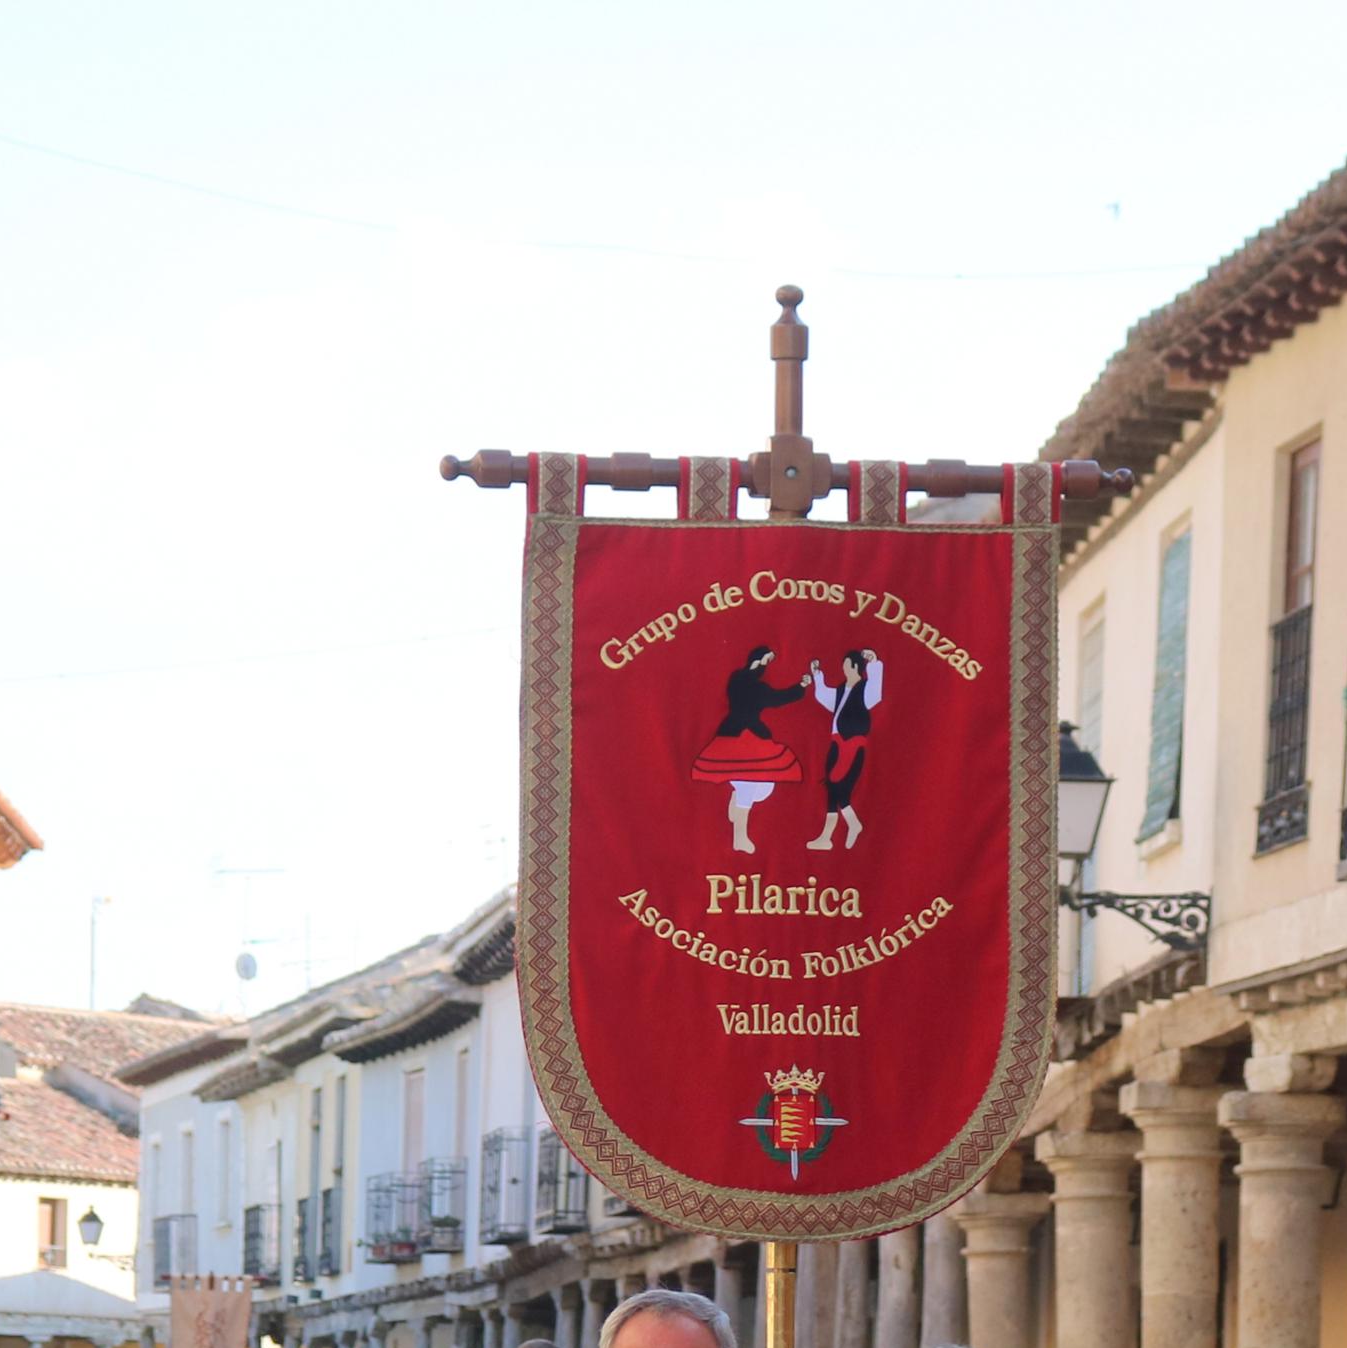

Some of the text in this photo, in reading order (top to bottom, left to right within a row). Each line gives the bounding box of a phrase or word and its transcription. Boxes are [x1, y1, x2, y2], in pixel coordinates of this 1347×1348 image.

[599, 570, 983, 681] Grupo de Coros y Danzas
[705, 874, 862, 917] Pilarica
[618, 888, 954, 980] Asociación Folklórica
[716, 1004, 860, 1037] Valladolid
